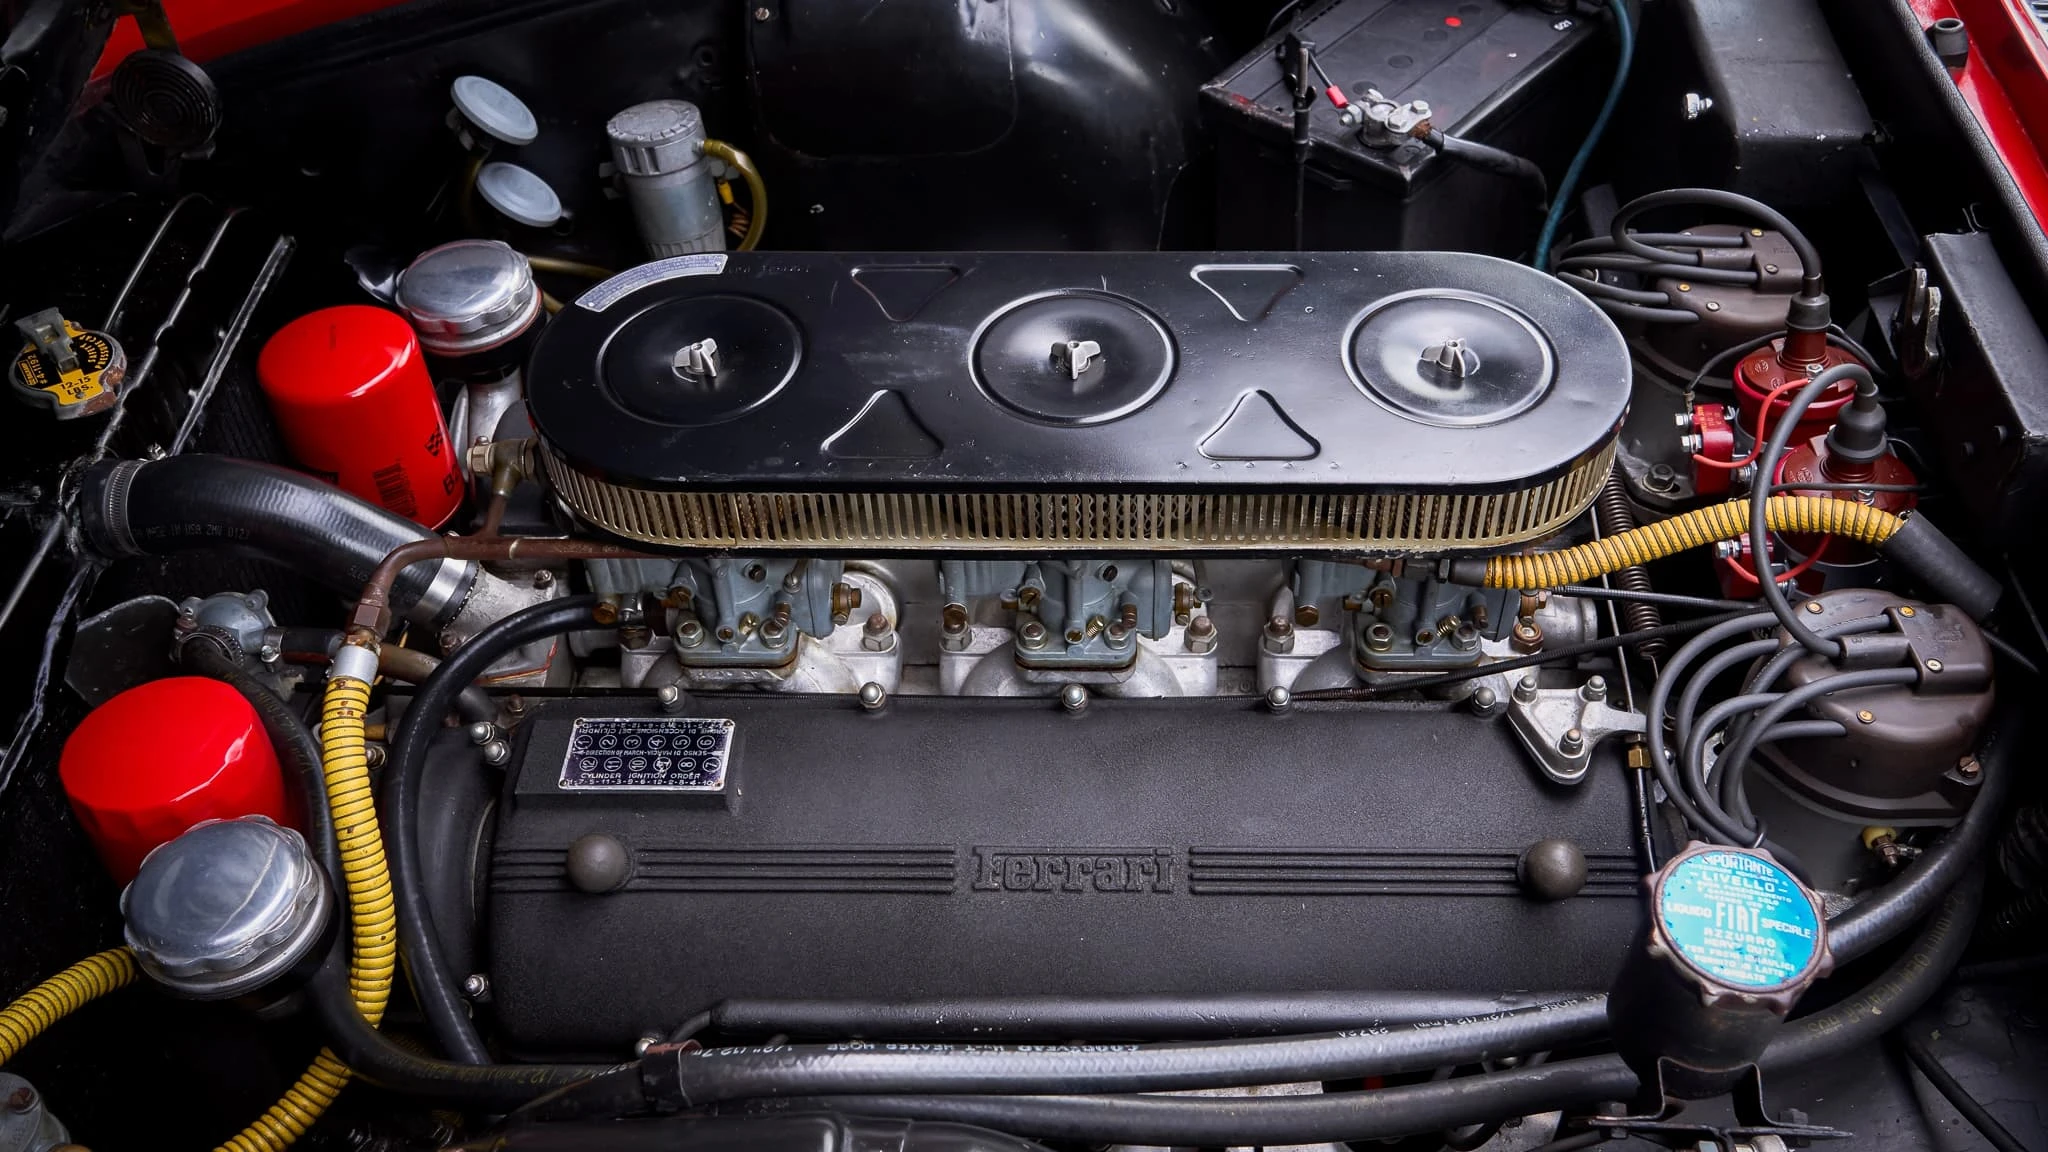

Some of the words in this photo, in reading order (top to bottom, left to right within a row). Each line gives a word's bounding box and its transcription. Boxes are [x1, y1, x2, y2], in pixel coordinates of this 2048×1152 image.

[60, 376, 92, 390] 12-15
[628, 772, 666, 780] IGNITION
[973, 846, 1176, 892] Ferrari
[1702, 871, 1775, 893] LIVELLO
[1715, 903, 1761, 934] FIAT
[1761, 918, 1813, 939] SPECIALE
[1704, 927, 1776, 948] AZZURRO
